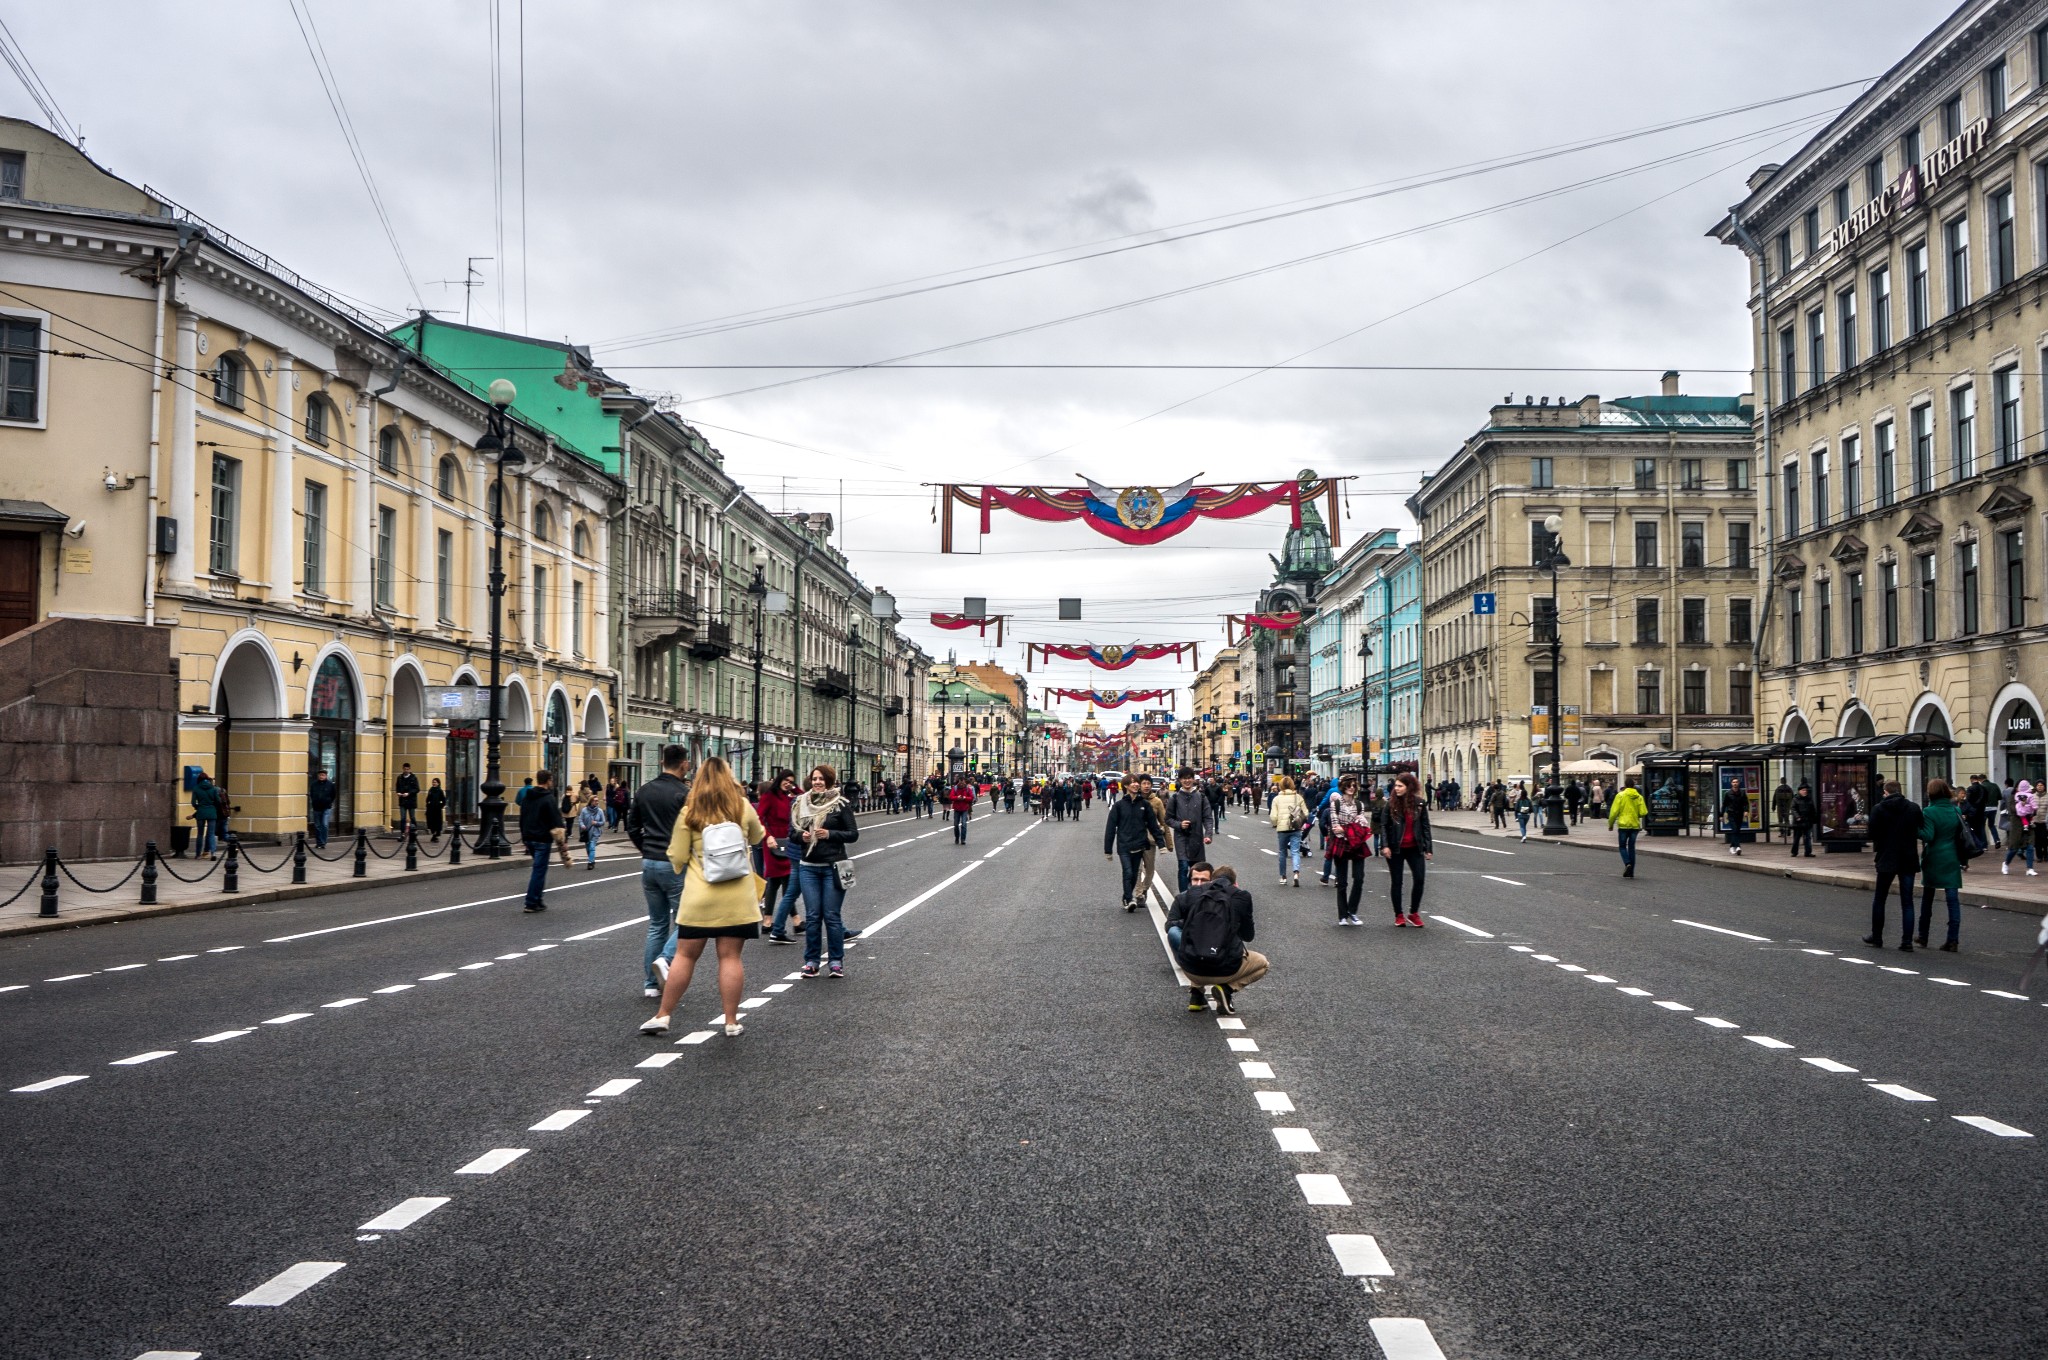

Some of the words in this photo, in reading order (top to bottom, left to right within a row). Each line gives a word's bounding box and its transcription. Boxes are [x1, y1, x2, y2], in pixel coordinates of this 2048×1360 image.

[1830, 188, 1893, 256] БИЗНЕС
[1922, 117, 1989, 190] ЦЕНТР
[2008, 718, 2031, 729] LUSH
